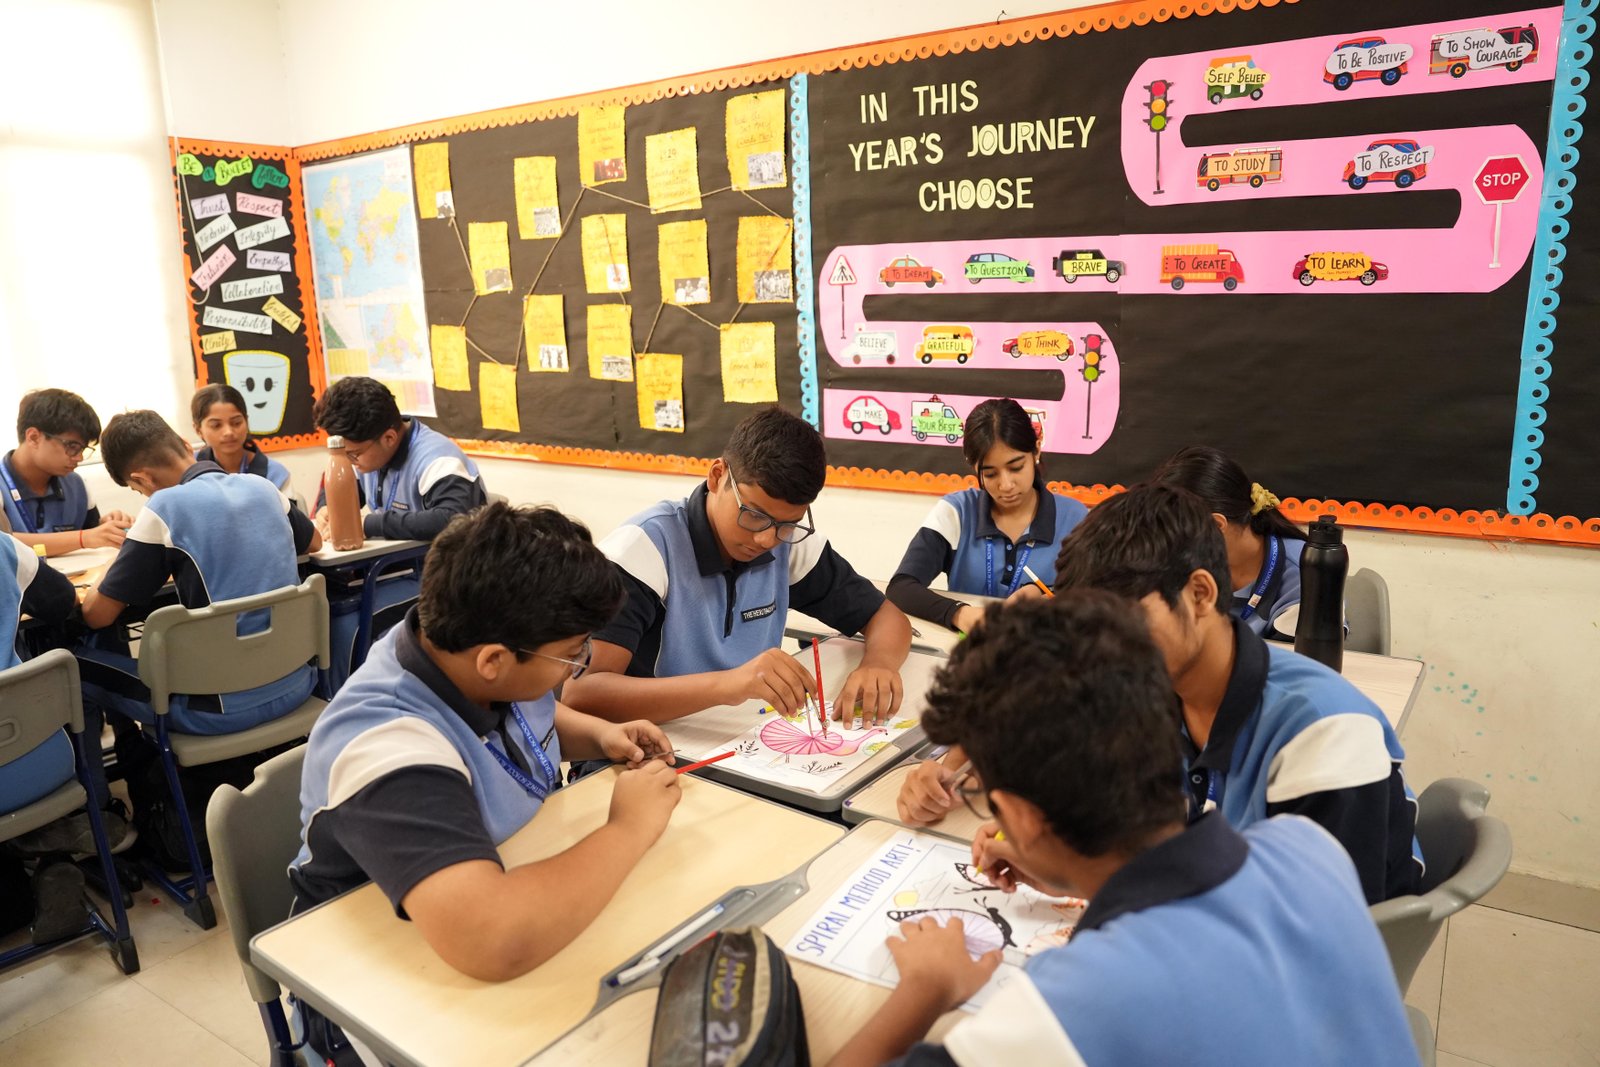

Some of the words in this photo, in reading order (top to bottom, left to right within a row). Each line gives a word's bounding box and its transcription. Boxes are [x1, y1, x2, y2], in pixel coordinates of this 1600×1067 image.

[1447, 40, 1459, 54] TO
[1463, 36, 1496, 50] SHOW
[1337, 54, 1348, 70] TO
[1352, 52, 1362, 68] BE
[1368, 48, 1406, 66] POSITIVE
[1476, 46, 1524, 62] COURAGE
[1208, 69, 1234, 83] SELF
[860, 92, 888, 124] IN
[912, 80, 979, 116] THIS
[848, 132, 944, 172] YEAR'S
[967, 116, 1096, 158] JOURNEY
[1214, 160, 1228, 172] TO
[1234, 158, 1266, 172] STUDY
[1358, 154, 1372, 172] TO
[1379, 151, 1428, 168] RESPECT
[1482, 172, 1521, 188] STOP
[918, 177, 1034, 212] CHOOSE
[980, 264, 1024, 276] QUESTION
[1072, 261, 1102, 274] BRAVE
[1174, 258, 1186, 270] TO
[1192, 257, 1226, 270] CREATE
[1311, 257, 1326, 270] TO
[1332, 257, 1365, 270] LEARN
[860, 337, 887, 348] BELIEVE
[927, 341, 966, 352] GRATEFUL
[1035, 336, 1060, 349] THINK
[864, 410, 882, 419] MAKE
[918, 420, 936, 431] YOUR
[938, 418, 957, 432] BEST
[796, 909, 852, 957] SPIRAL
[839, 868, 892, 912] METHOD
